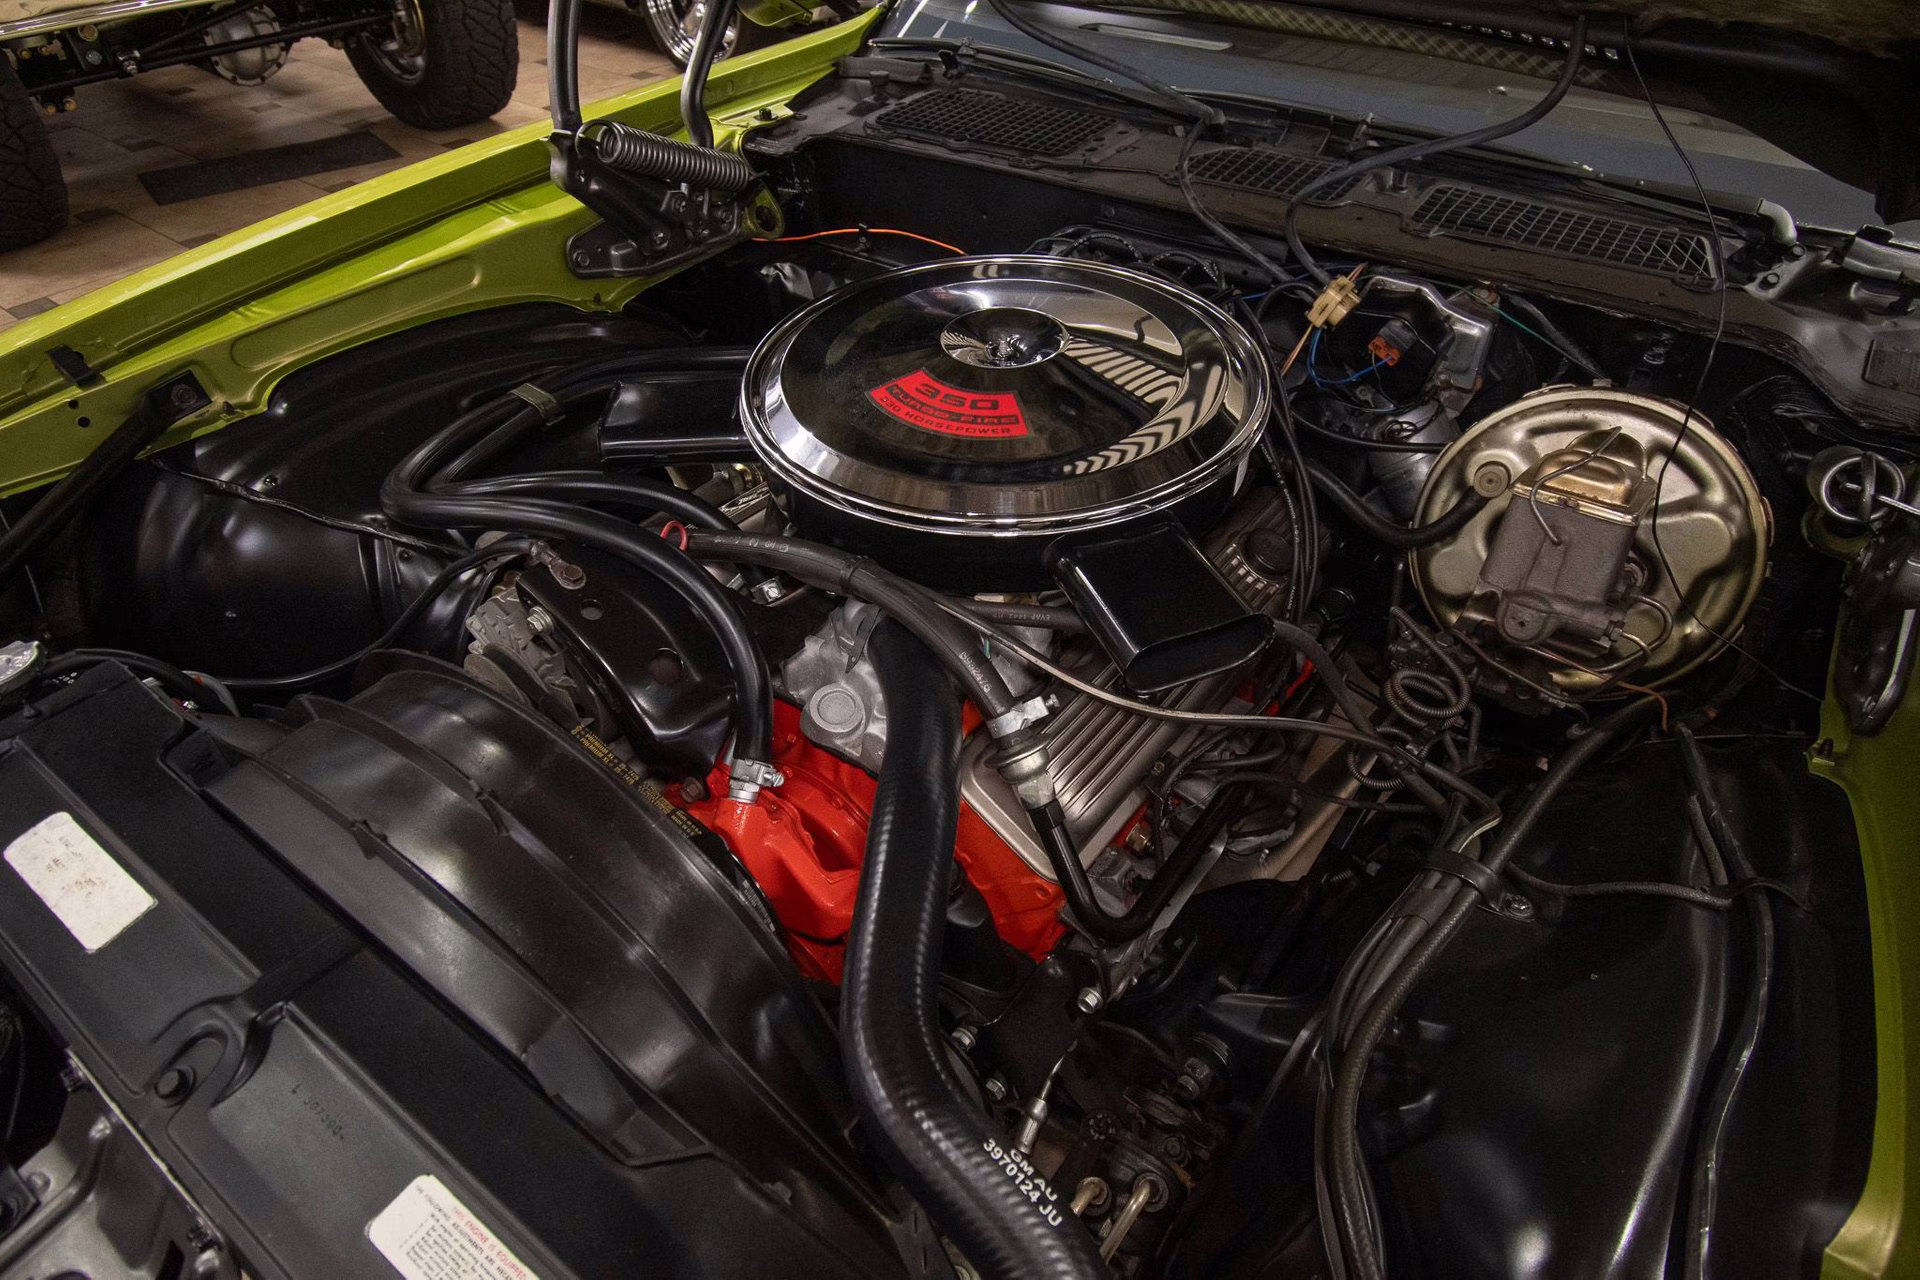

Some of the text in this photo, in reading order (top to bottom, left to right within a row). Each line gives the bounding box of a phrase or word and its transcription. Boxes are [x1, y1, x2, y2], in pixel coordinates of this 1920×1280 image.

[915, 383, 999, 410] 350
[905, 411, 1011, 434] HORSEPOWER
[983, 1138, 1063, 1227] 3970124 JU
[1010, 1149, 1058, 1201] GM AU
